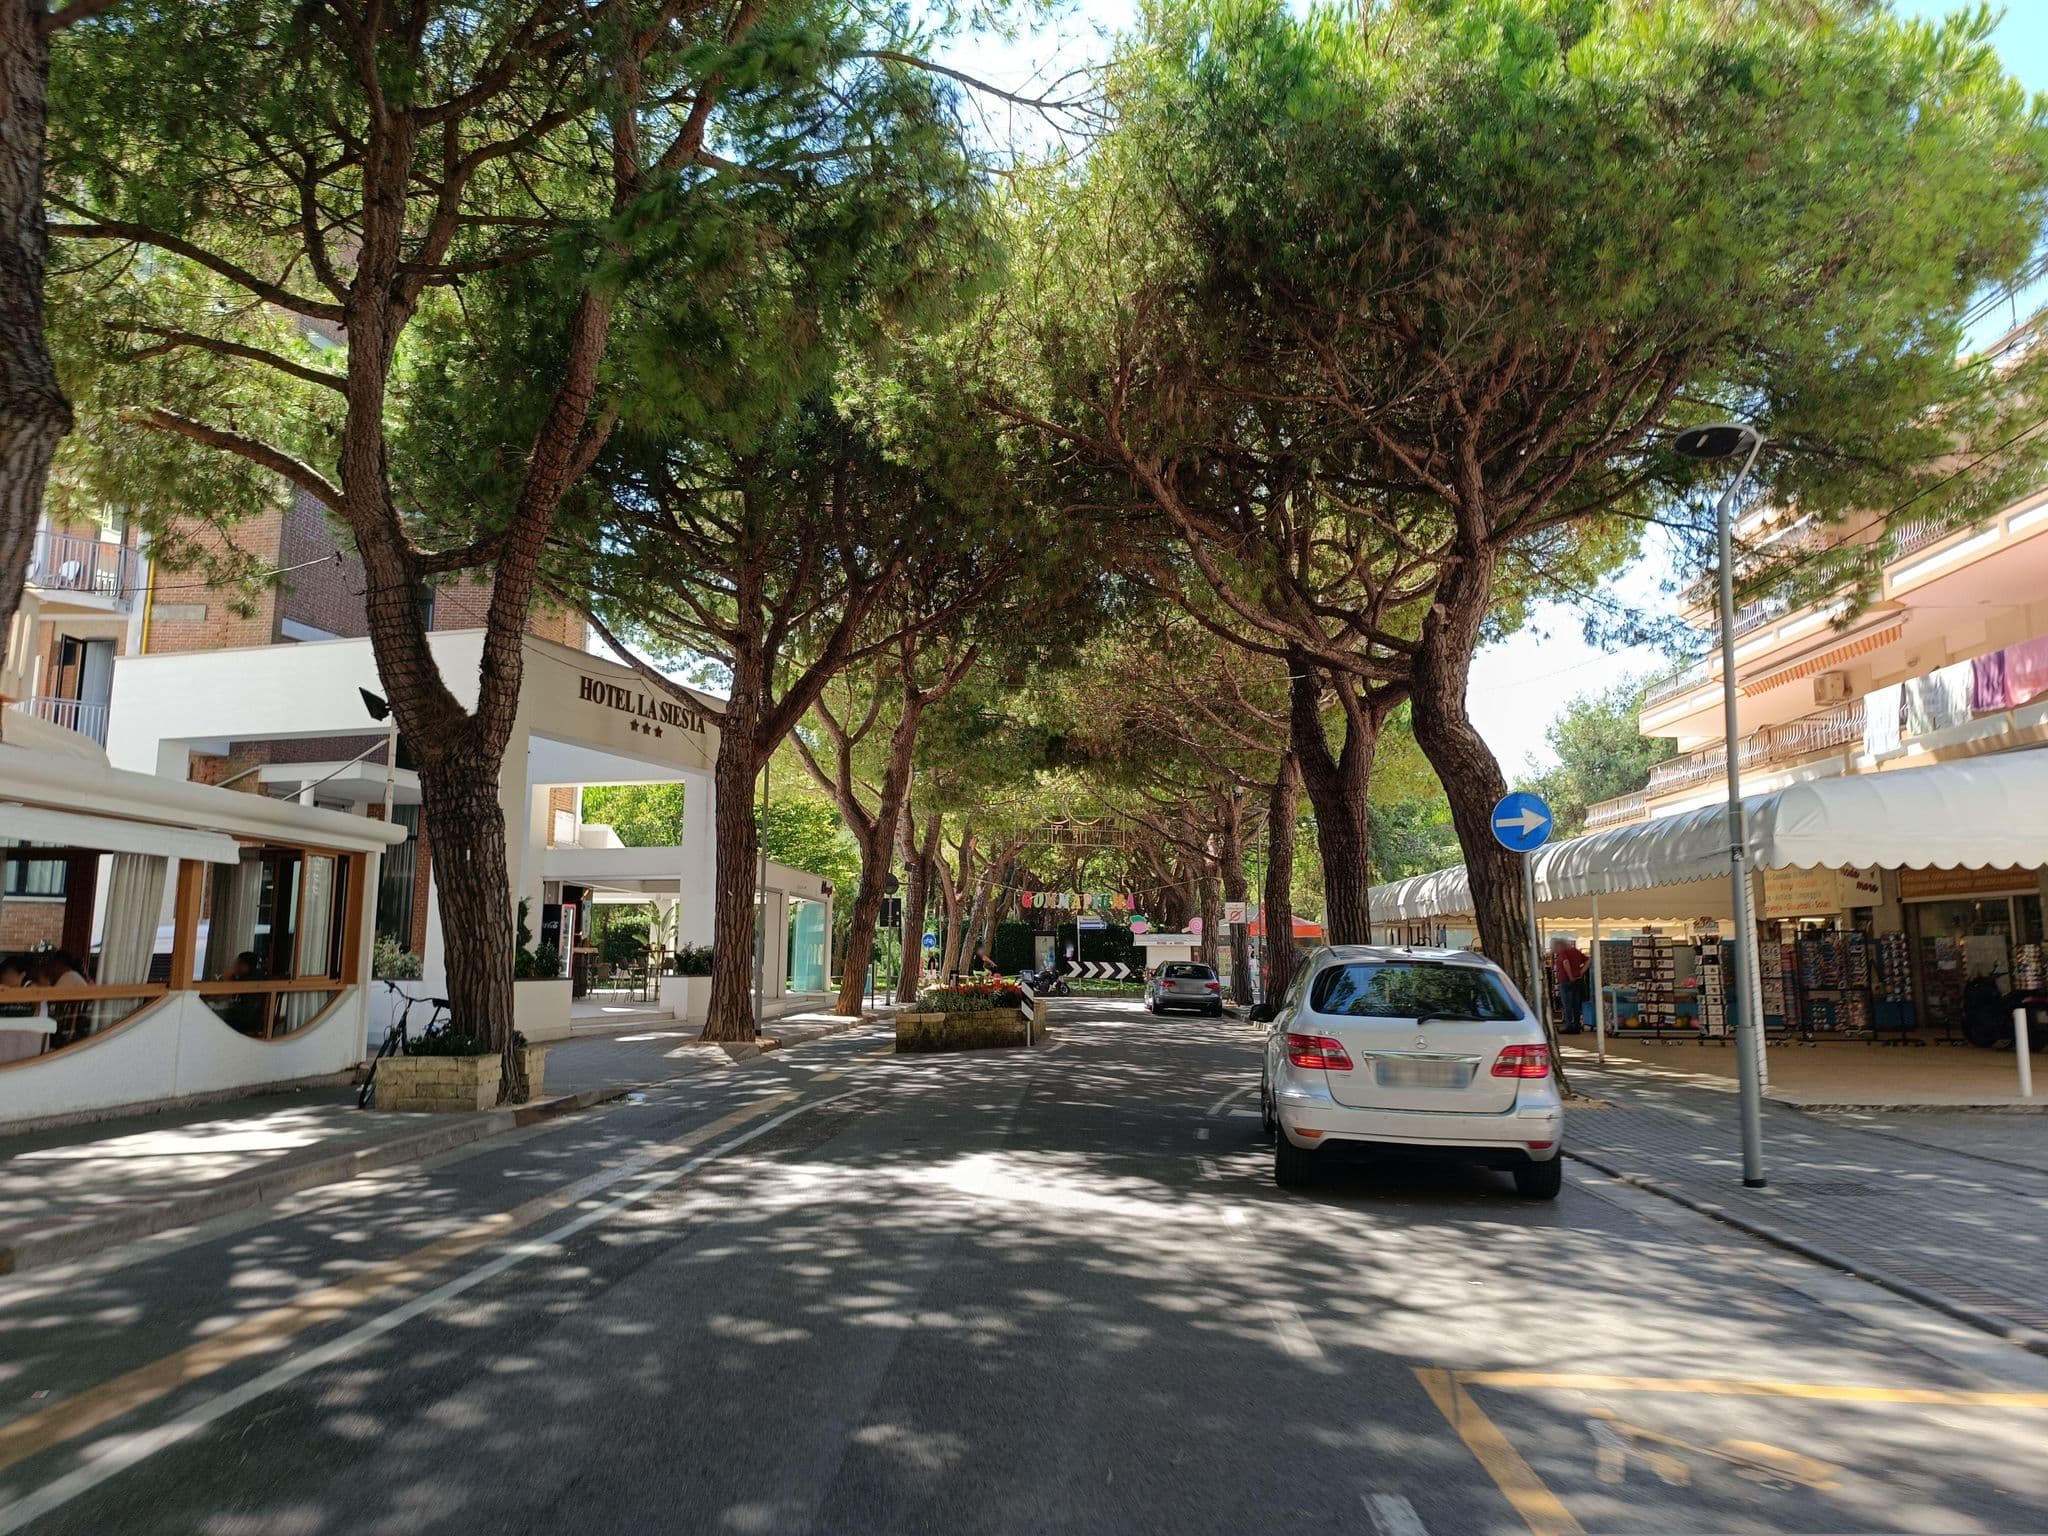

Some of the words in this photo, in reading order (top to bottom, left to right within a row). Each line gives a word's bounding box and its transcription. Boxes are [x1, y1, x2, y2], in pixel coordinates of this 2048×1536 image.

[579, 675, 635, 714] HOTEL
[637, 693, 658, 721] LA
[660, 701, 706, 734] SIESTA
